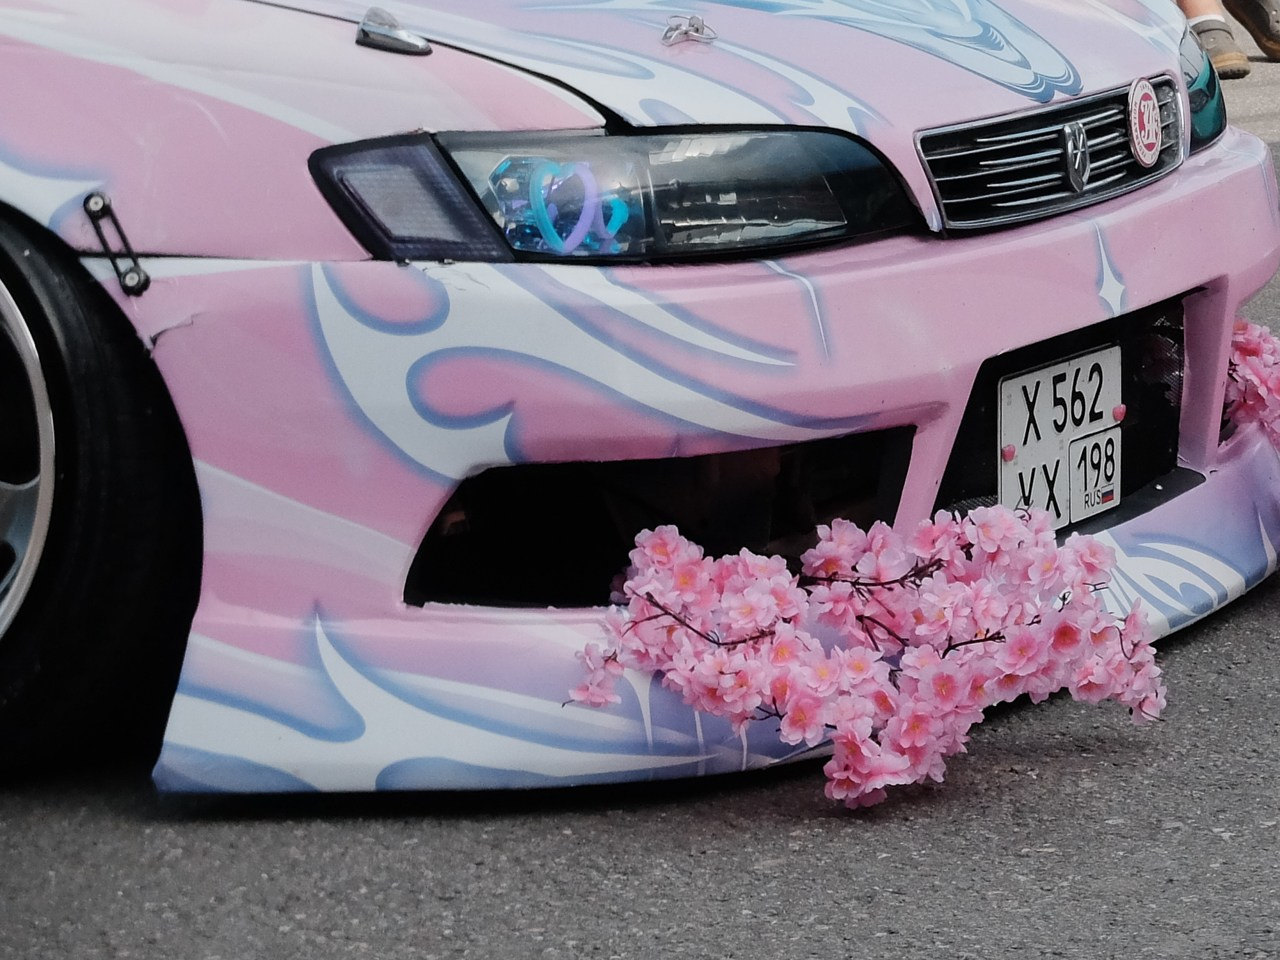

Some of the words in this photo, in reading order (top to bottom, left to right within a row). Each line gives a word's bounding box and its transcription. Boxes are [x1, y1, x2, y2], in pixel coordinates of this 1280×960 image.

[1021, 380, 1041, 447] X
[1052, 362, 1104, 433] 562
[1077, 437, 1115, 492] 198
[1084, 489, 1102, 509] RUS
